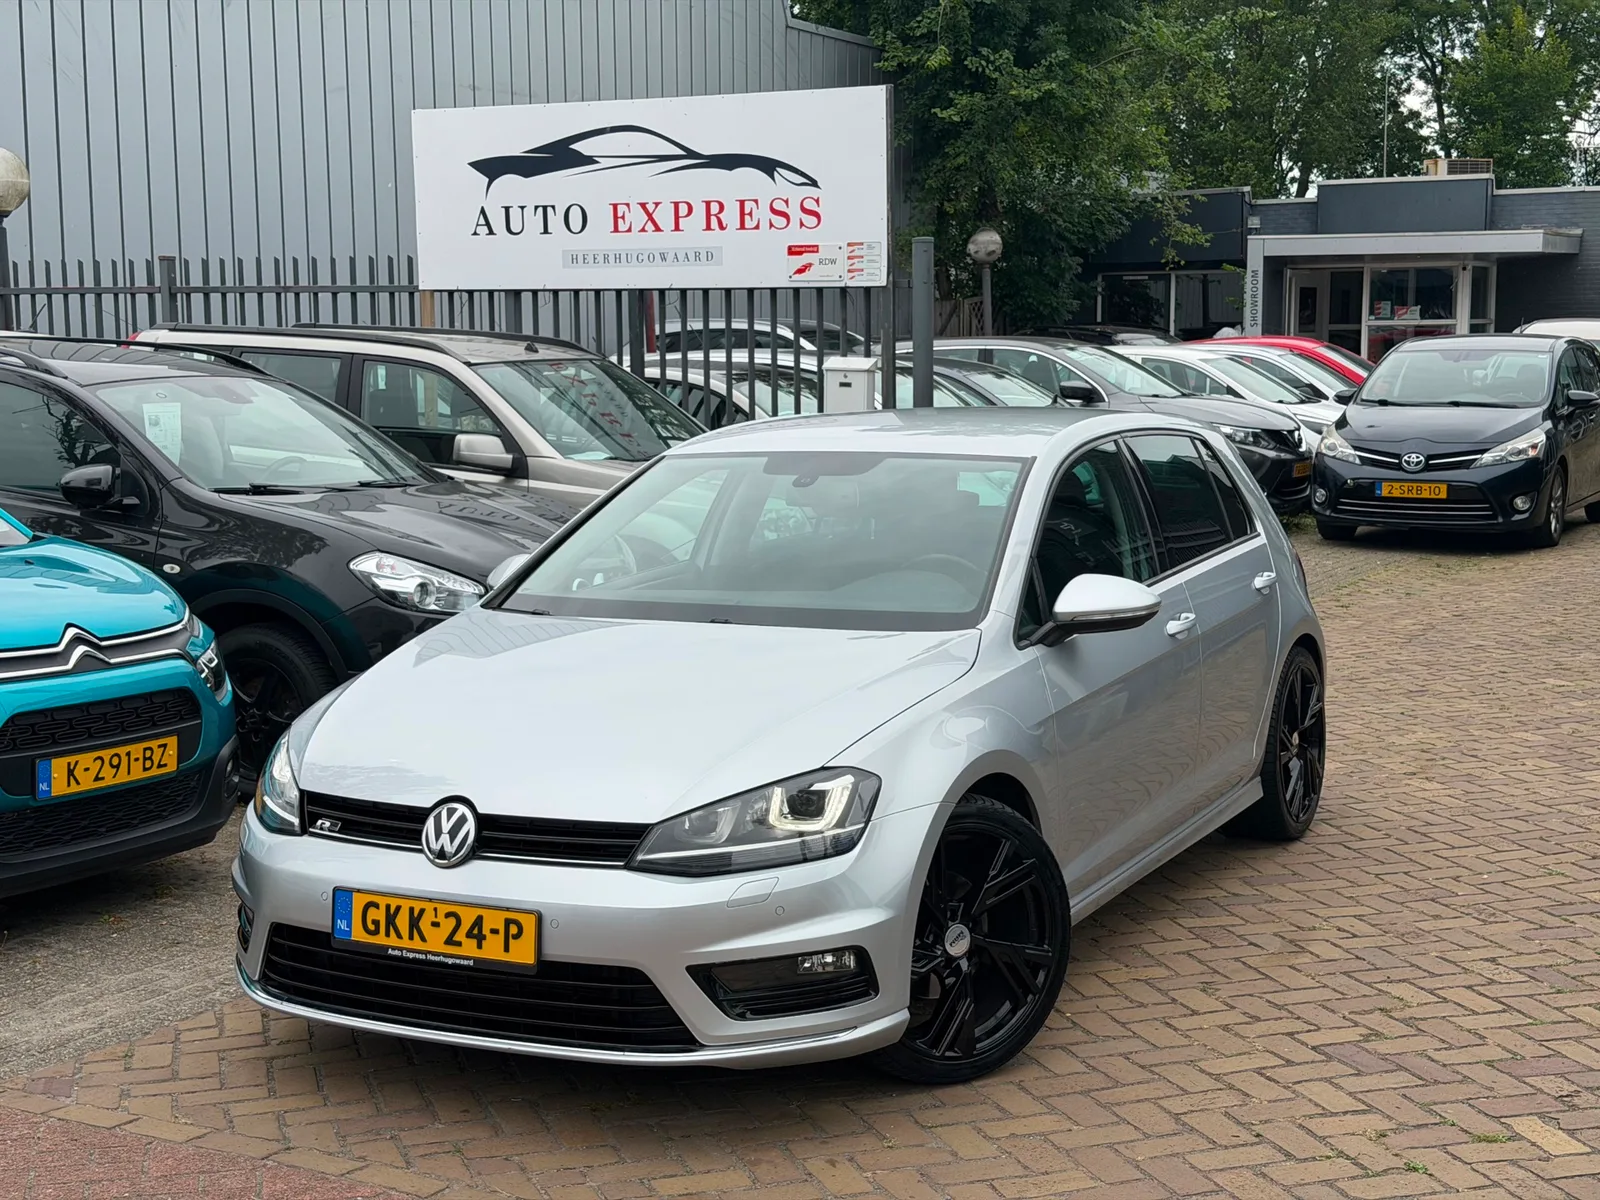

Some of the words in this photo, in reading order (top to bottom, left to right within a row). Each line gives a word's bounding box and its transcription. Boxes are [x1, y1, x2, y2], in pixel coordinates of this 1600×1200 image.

[471, 203, 588, 236] AUTO
[609, 197, 822, 234] EXPRESS
[570, 250, 715, 265] HEERHUGOWAARD
[818, 258, 838, 266] RDW
[1249, 269, 1260, 328] SHOWROOM
[1387, 484, 1441, 497] 2-SRB-10
[39, 782, 50, 791] NL
[66, 743, 169, 787] K-291-BZ
[336, 918, 350, 931] NL
[387, 948, 402, 956] Auto
[402, 950, 426, 959] Express
[426, 953, 474, 966] Heerhugowaard
